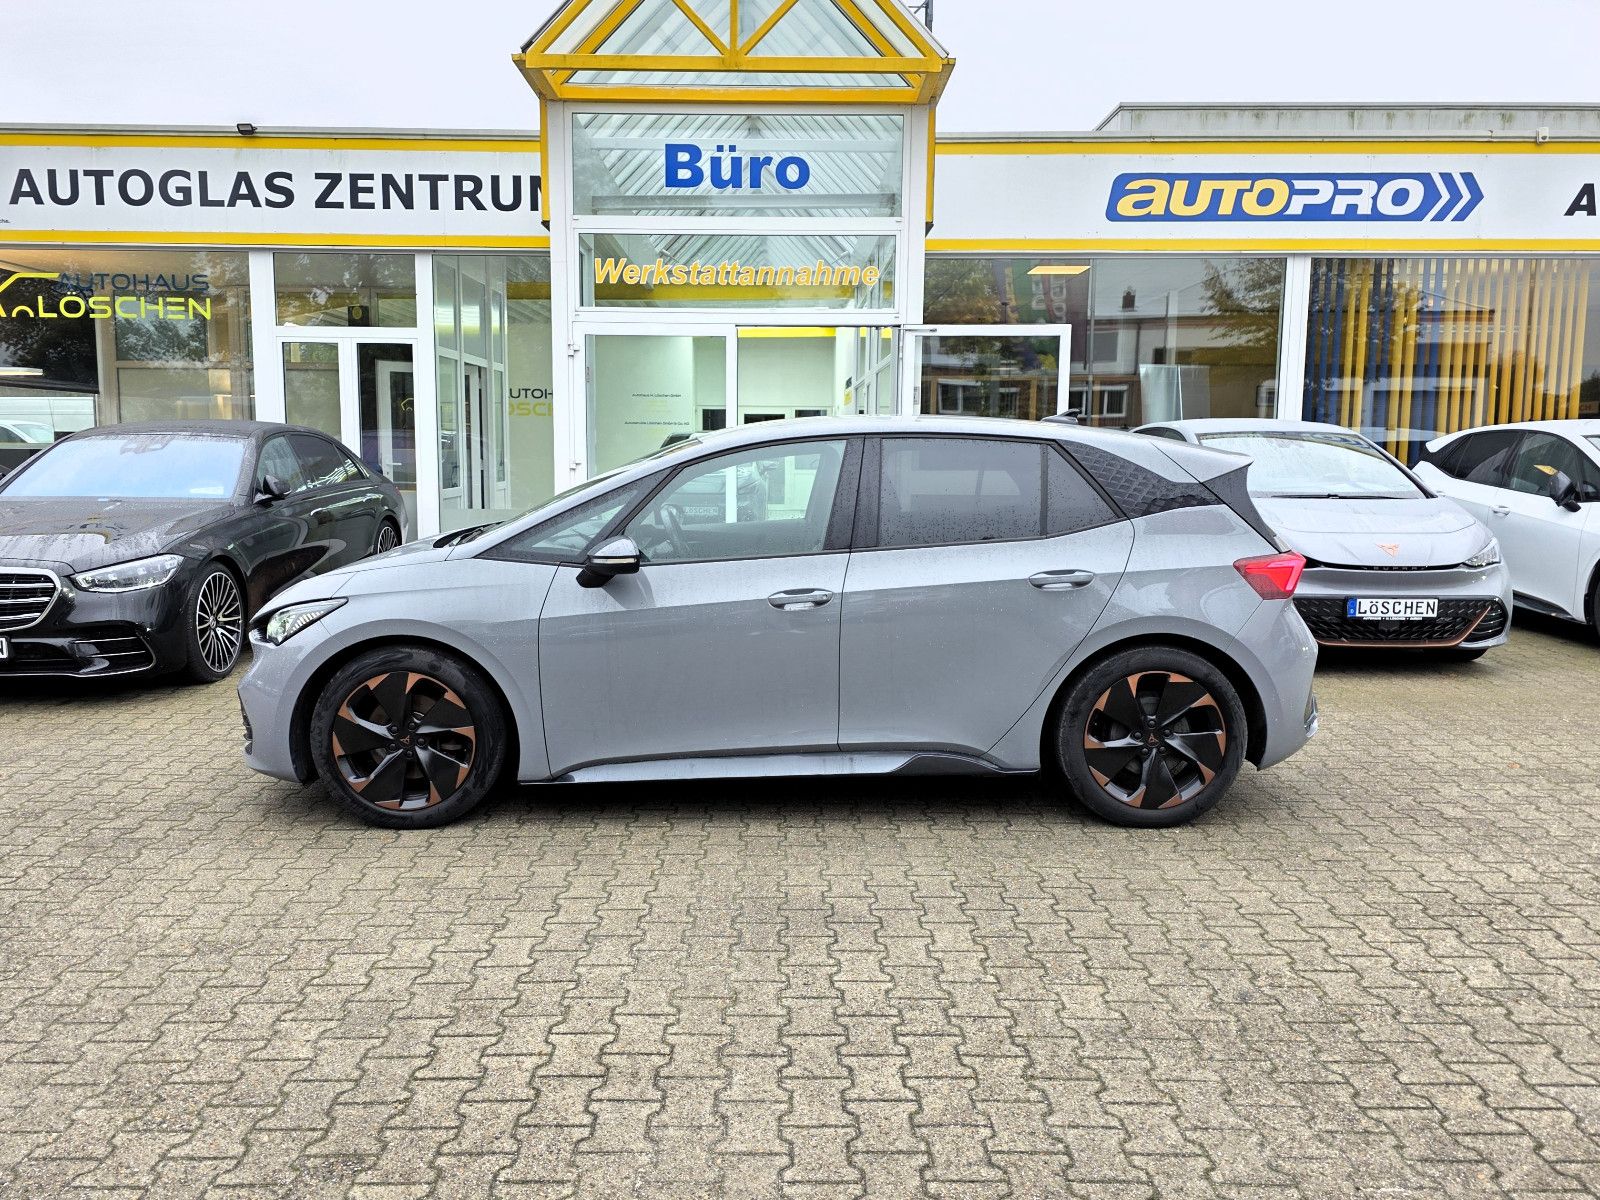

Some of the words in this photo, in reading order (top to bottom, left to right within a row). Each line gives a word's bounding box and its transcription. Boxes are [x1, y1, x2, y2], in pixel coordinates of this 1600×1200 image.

[664, 143, 811, 189] Büro
[9, 168, 295, 209] AUTOGLAS
[57, 272, 210, 292] AUTOHAUS
[594, 257, 880, 287] Werkstattannahme
[37, 291, 212, 320] LÖSCHEN
[509, 388, 553, 399] UTOH
